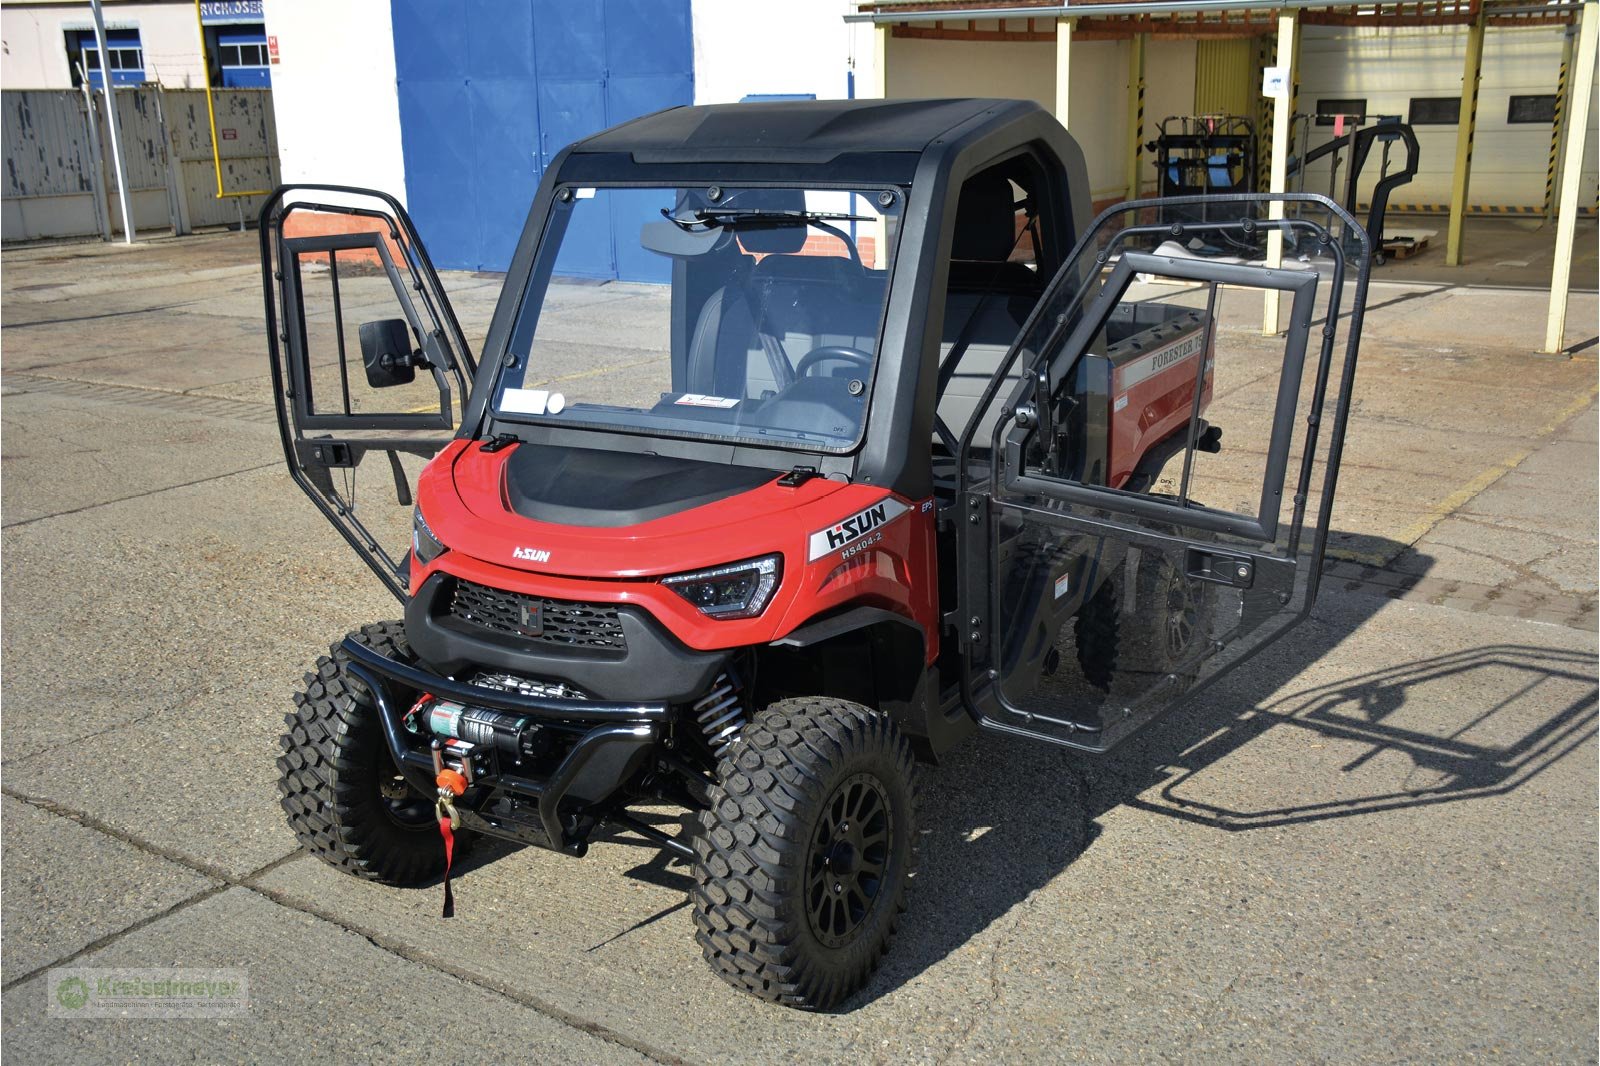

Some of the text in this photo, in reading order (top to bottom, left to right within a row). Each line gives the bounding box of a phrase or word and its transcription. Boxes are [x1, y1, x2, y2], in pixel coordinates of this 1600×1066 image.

[1151, 339, 1193, 371] FORESTER
[921, 500, 933, 513] EPS
[826, 504, 887, 550] HSUN
[841, 532, 882, 560] HS404-2
